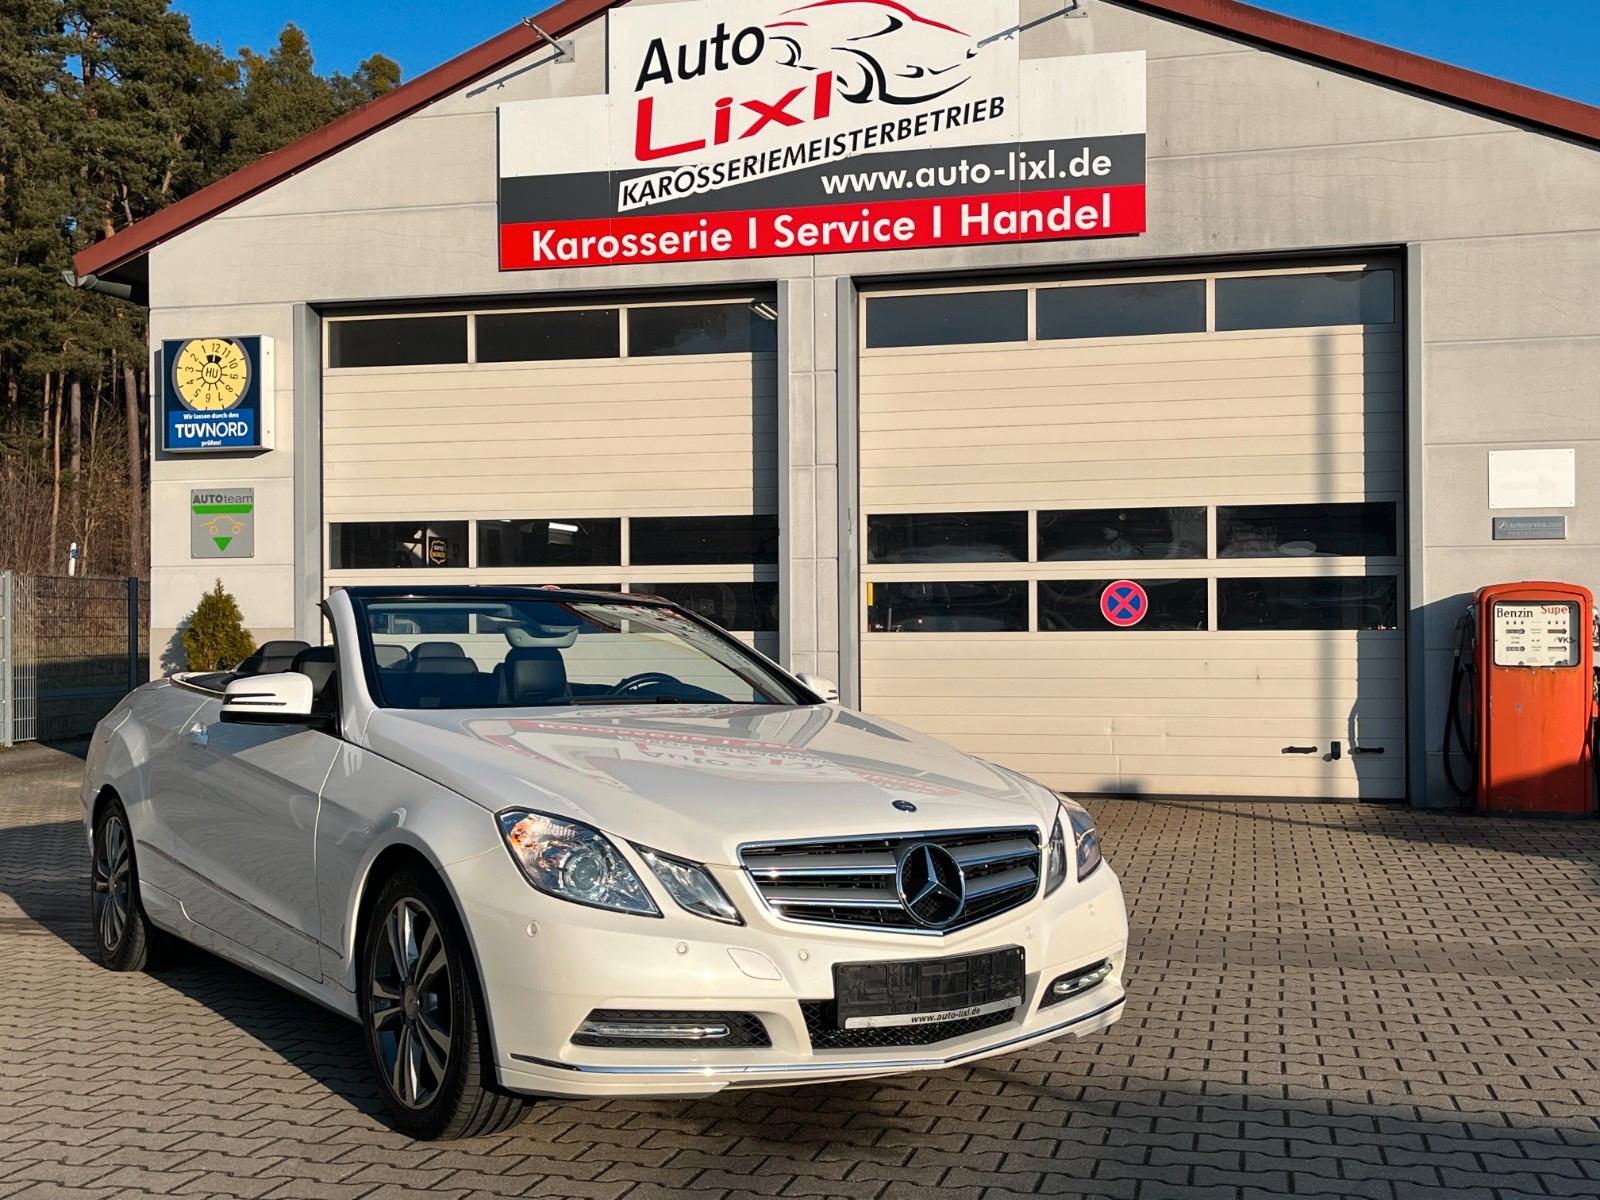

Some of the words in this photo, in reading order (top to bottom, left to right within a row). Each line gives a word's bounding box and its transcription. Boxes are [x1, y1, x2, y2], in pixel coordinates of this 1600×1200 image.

[634, 23, 765, 91] Auto
[635, 71, 833, 161] Lixl
[621, 96, 1005, 207] KAROSSERIEMEISTERBETRIEB
[822, 149, 1112, 196] www.auto-lixl.de
[533, 219, 732, 261] Karosserie
[775, 208, 916, 248] Service
[961, 193, 1112, 236] Handel
[212, 343, 220, 353] 12
[222, 348, 231, 358] 11
[228, 358, 238, 369] 10
[206, 368, 218, 378] HU
[194, 389, 201, 397] 5
[206, 394, 210, 402] 6
[1497, 608, 1533, 618] Benzin
[911, 1007, 980, 1023] www.auto-lixl.de
